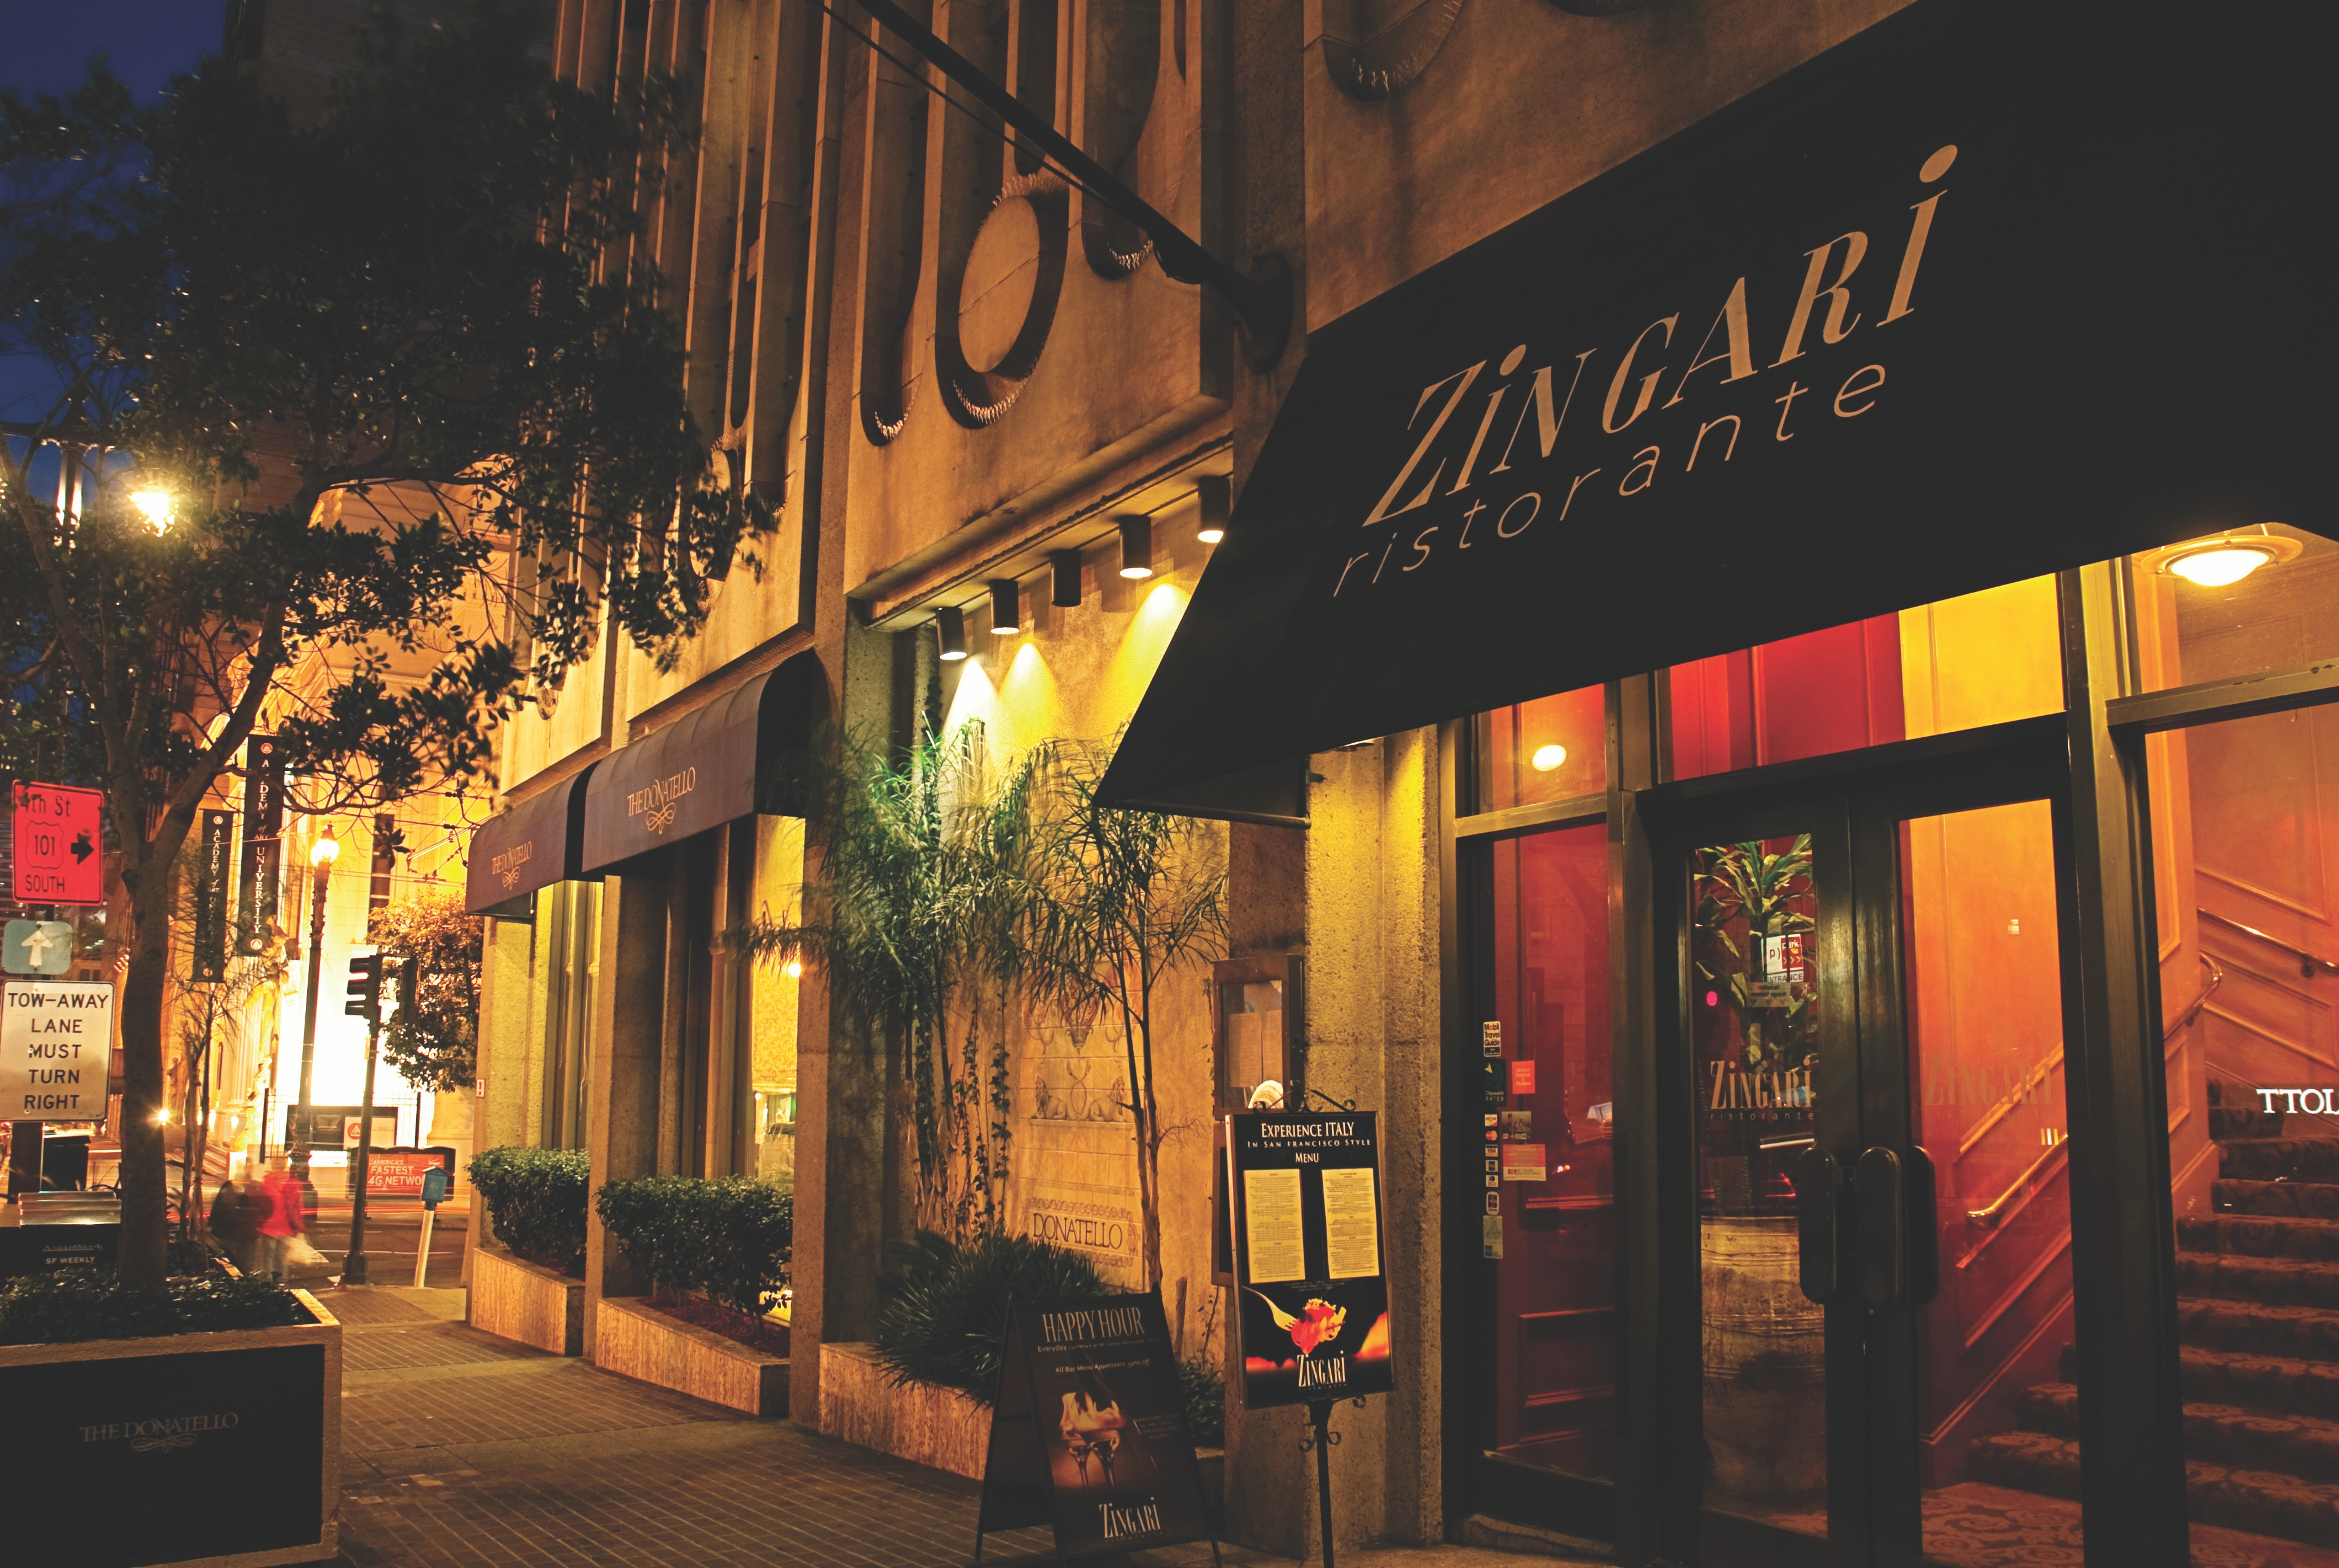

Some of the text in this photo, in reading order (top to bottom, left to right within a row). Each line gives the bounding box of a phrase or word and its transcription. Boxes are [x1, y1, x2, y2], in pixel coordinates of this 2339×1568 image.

[1334, 364, 1885, 596] ristorante
[258, 759, 269, 819] ADEMY
[627, 767, 696, 817] THE DONATELLO
[20, 792, 70, 817] 4th St
[35, 835, 55, 856] 101
[211, 829, 220, 876] ACADEMY
[492, 841, 532, 874] THE DONATELLO
[26, 874, 65, 893] SOUTH
[254, 847, 265, 934] UNIVERSITY
[8, 993, 109, 1008] TOW-AWAY
[31, 1018, 82, 1033] LANE
[29, 1044, 81, 1058] MUST
[29, 1070, 79, 1084] TURN
[25, 1095, 79, 1109] RIGHT
[1711, 1112, 1814, 1120] ristorante
[1325, 1122, 1354, 1137] ITALY
[370, 1166, 414, 1174] FASTEST
[368, 1176, 423, 1185] 4G NETWO
[1033, 1214, 1122, 1249] DONATELLO
[1042, 1307, 1145, 1343] HAPPY HOUR
[1038, 1345, 1067, 1353] Everyday
[1094, 1362, 1125, 1370] Appetizers
[1142, 1358, 1150, 1366] off
[79, 1413, 239, 1442] THE DONATELLO
